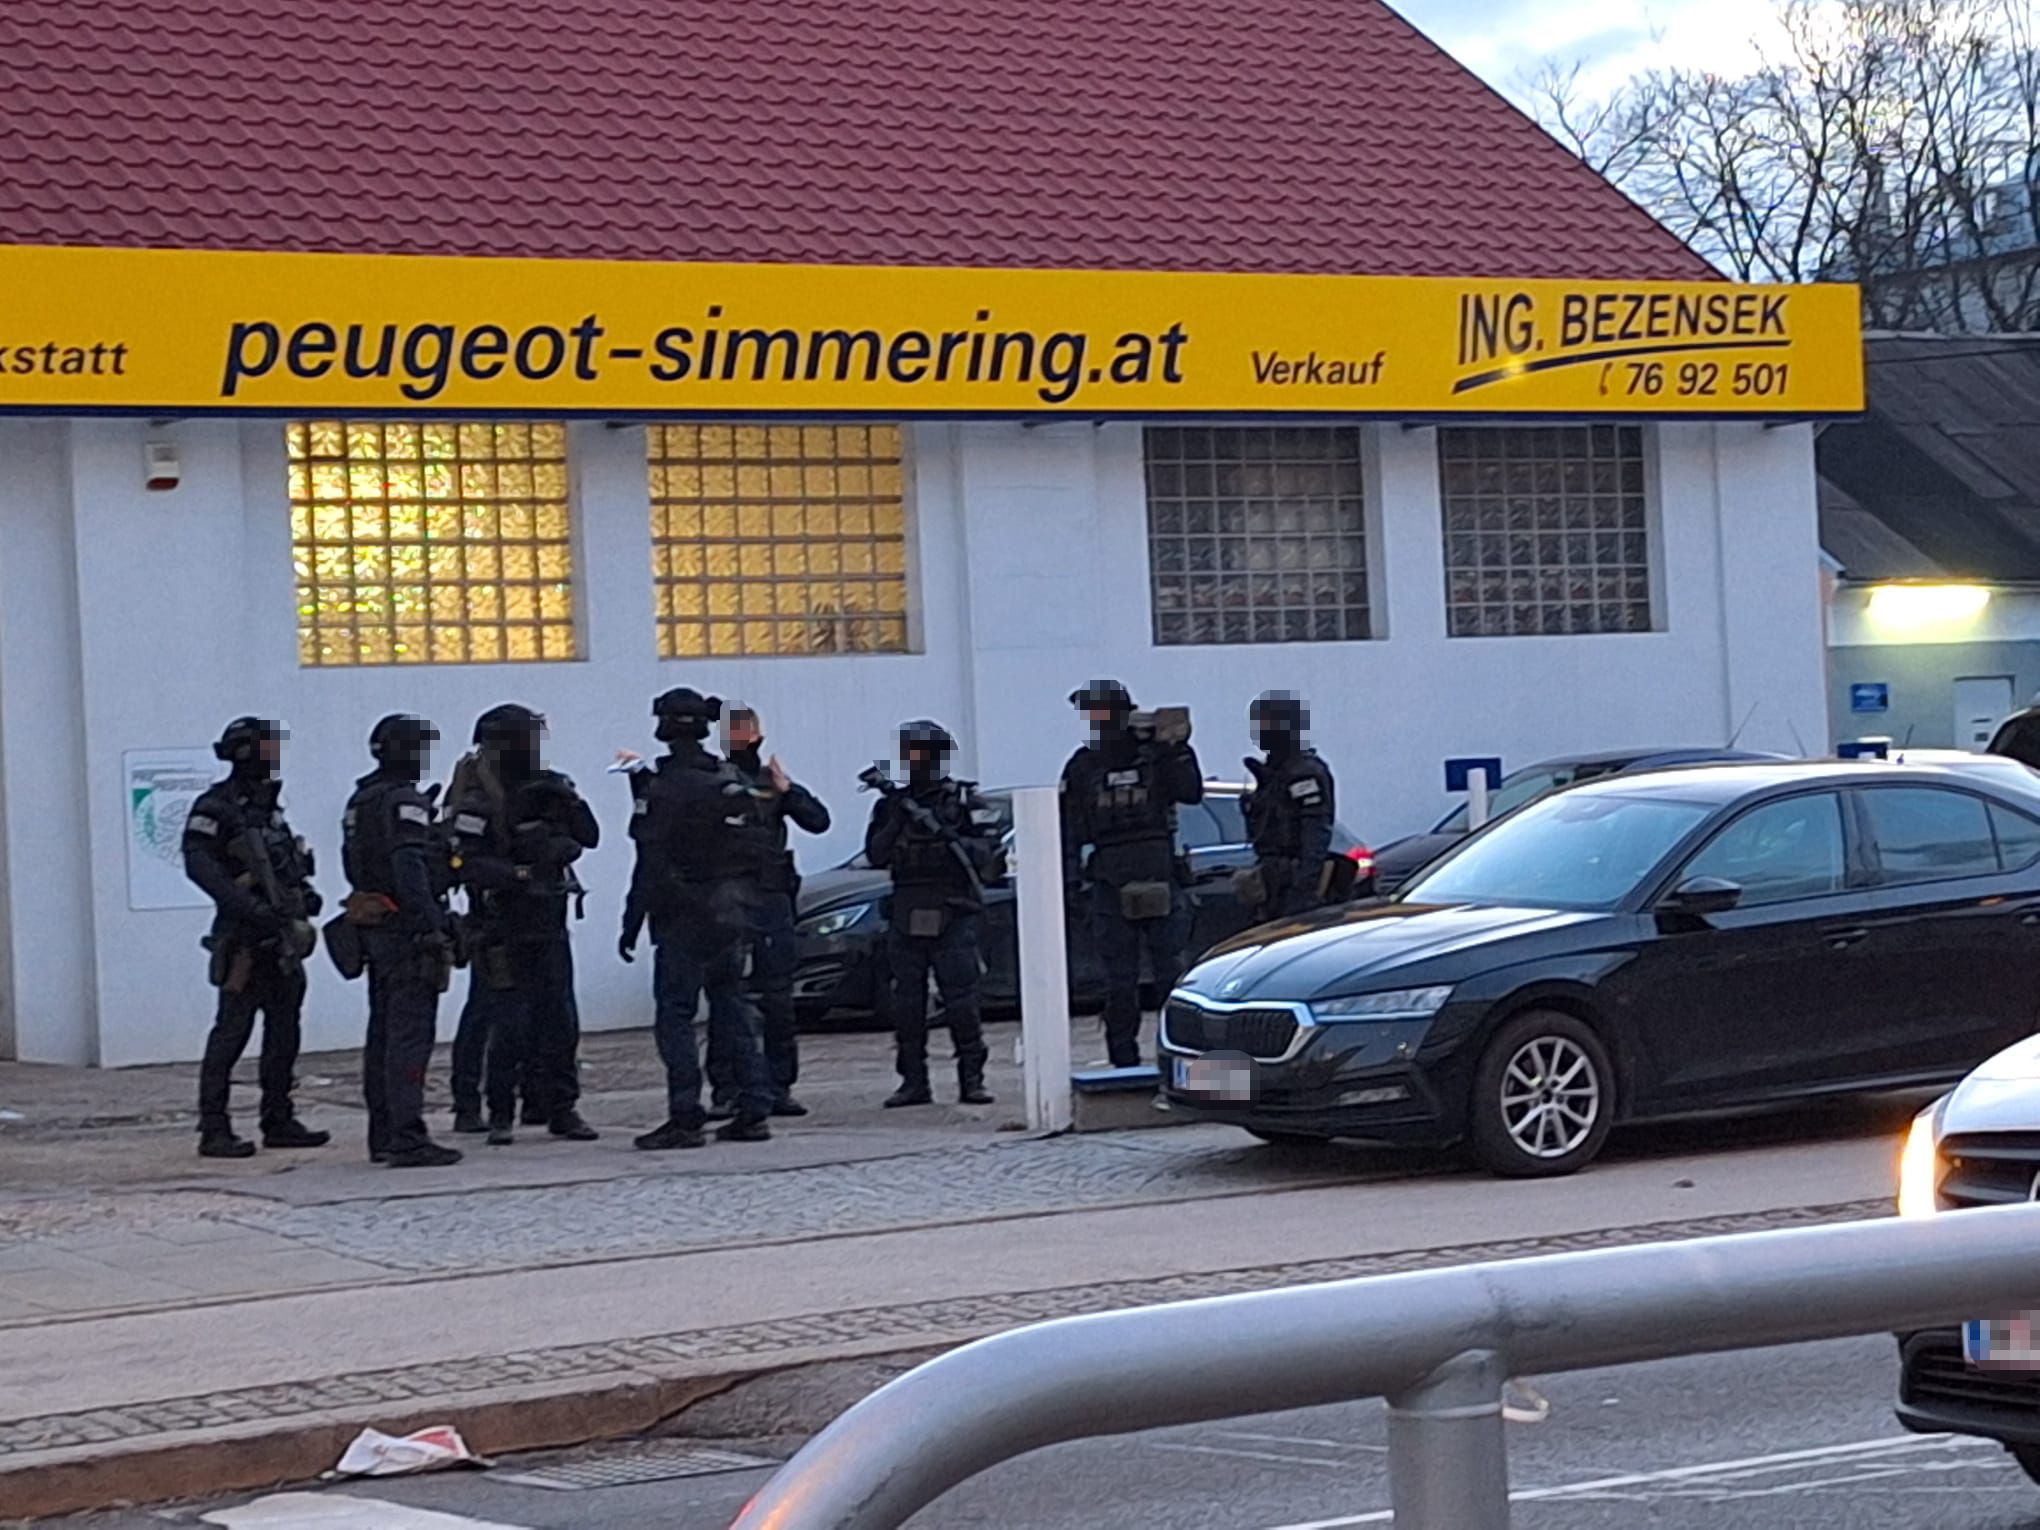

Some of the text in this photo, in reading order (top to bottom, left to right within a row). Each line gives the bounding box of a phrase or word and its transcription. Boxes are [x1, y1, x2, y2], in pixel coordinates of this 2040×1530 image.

[220, 305, 1189, 402] peugeot-simmering.at
[1458, 292, 1790, 365] ING. BEZENSEK
[1251, 350, 1386, 386] Verkauf
[1626, 362, 1789, 396] 76 92 501
